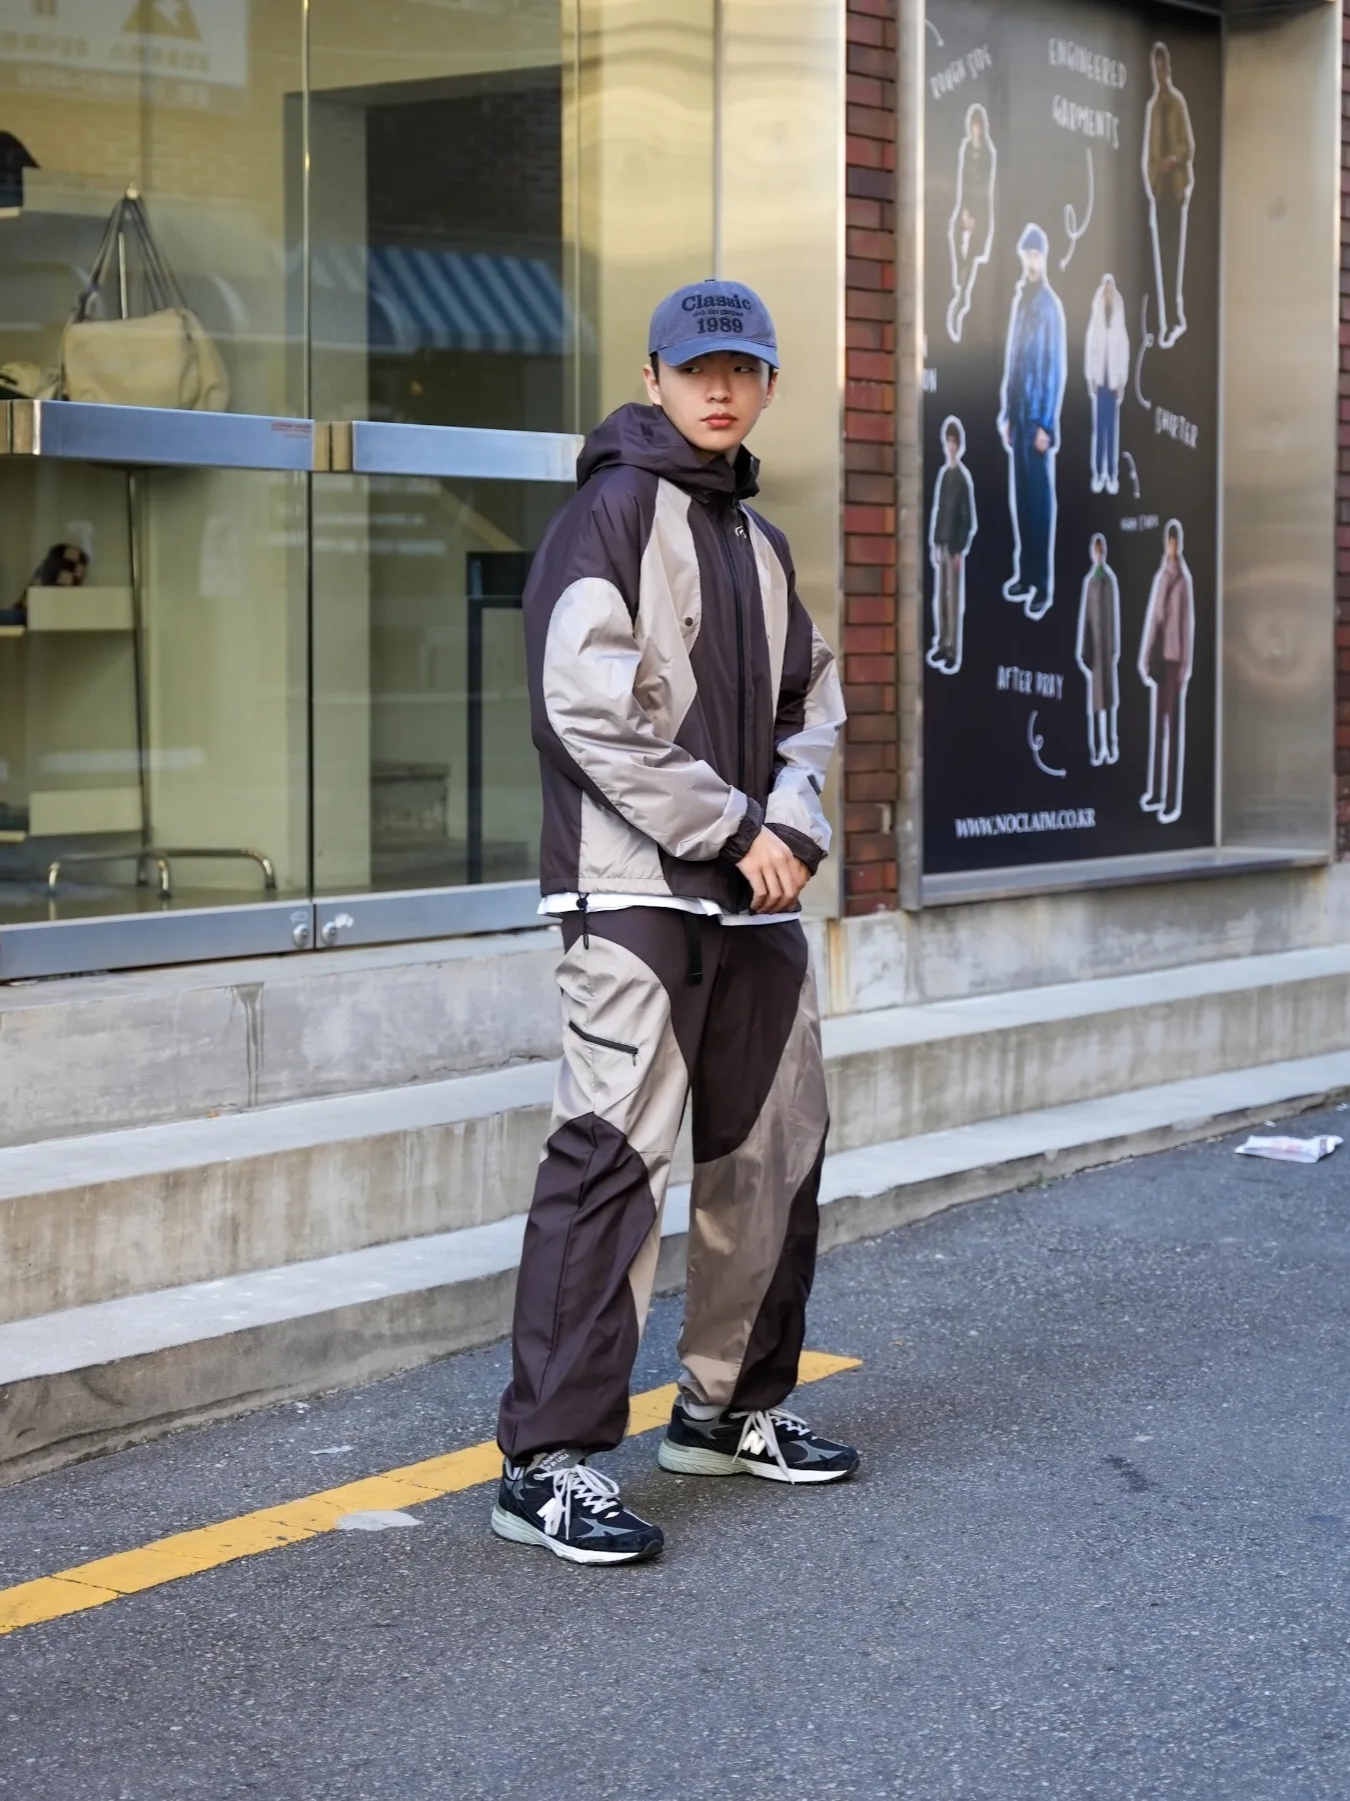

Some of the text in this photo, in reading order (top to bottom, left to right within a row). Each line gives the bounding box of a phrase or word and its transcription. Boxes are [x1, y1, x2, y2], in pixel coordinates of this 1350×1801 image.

[1047, 37, 1127, 89] ENGINEERED
[1053, 94, 1119, 150] GARMENTS
[681, 294, 752, 312] Classic
[697, 317, 743, 334] 1989
[997, 665, 1033, 695] AFTER
[955, 808, 1096, 839] WWW.NOCLAIM.CO.KR
